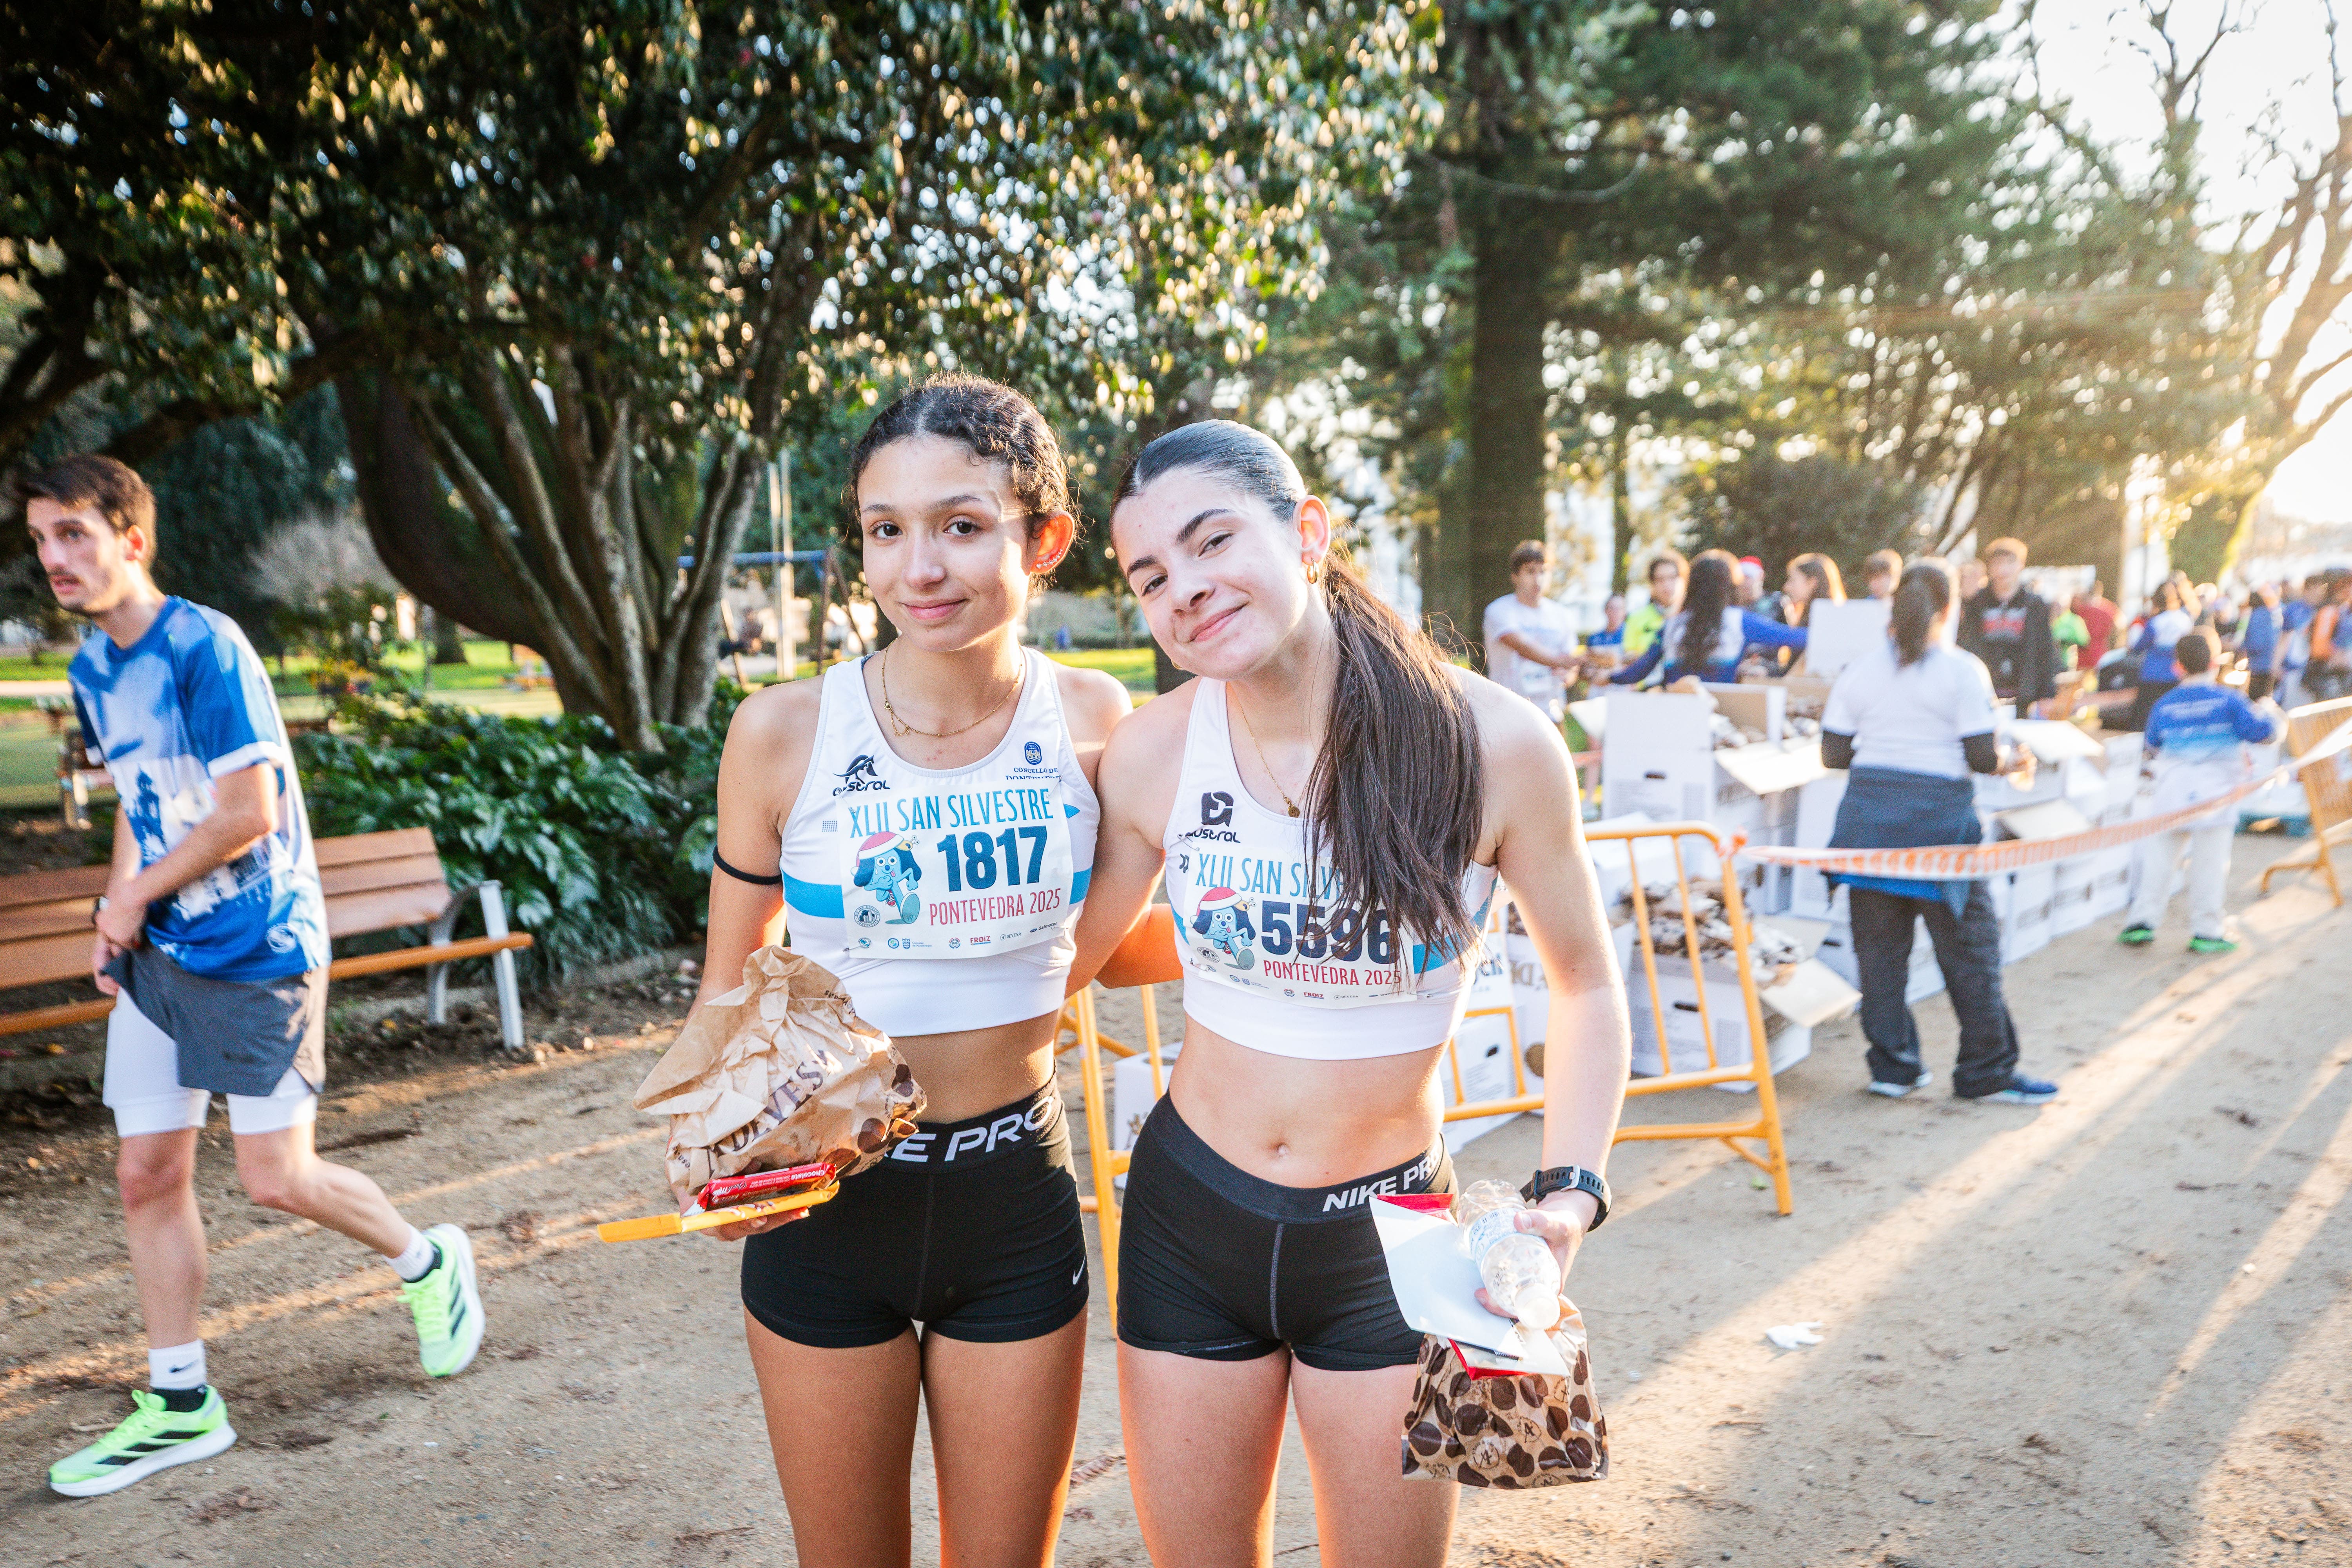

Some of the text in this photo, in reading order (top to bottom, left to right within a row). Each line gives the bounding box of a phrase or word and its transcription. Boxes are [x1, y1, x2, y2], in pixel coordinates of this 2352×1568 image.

[848, 788, 1054, 838] XLII SAN SILVESTRE
[936, 825, 1047, 892] 1817
[1195, 853, 1234, 888] XLII
[1239, 857, 1283, 895] SAN
[929, 888, 1061, 926] PONTEVEDRA 2025
[1038, 922, 1057, 930] Galmotor
[1261, 900, 1401, 965] 5596
[1263, 960, 1401, 985] PONTEVEDRA 2025
[944, 1095, 1055, 1162] PRO
[791, 1169, 825, 1181] Chocolate
[1322, 1149, 1439, 1212] NIKE PRO
